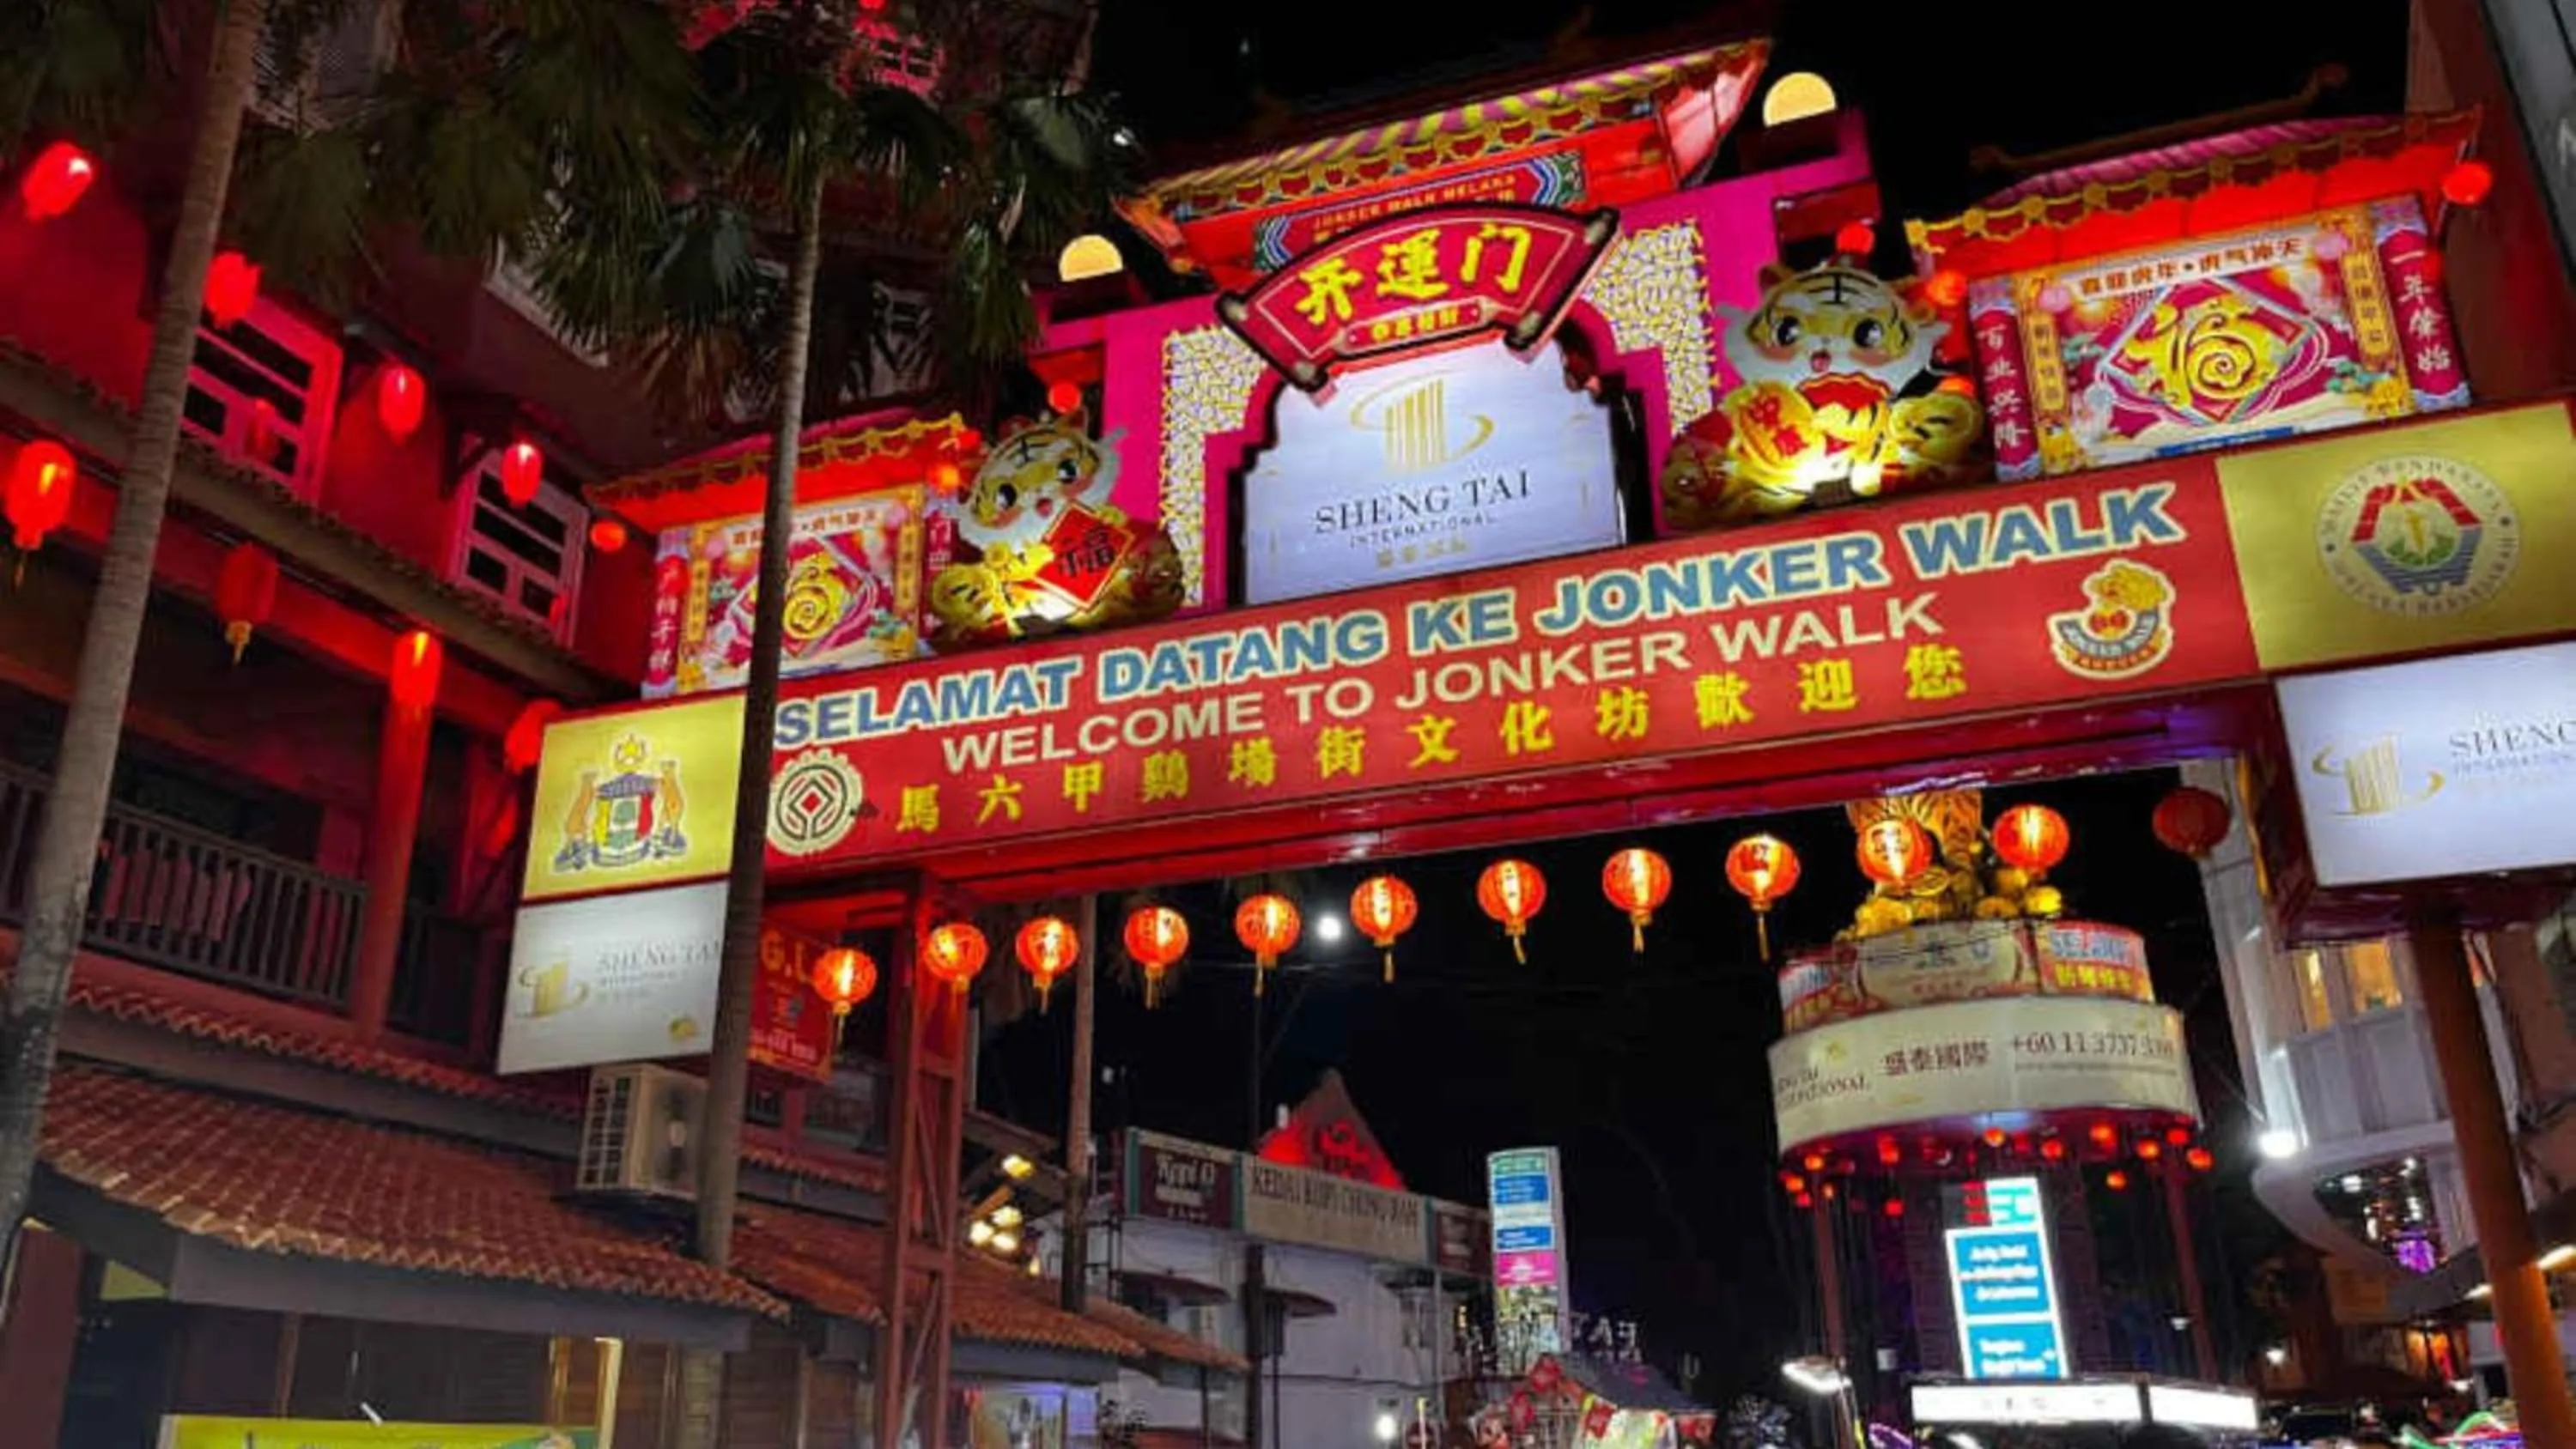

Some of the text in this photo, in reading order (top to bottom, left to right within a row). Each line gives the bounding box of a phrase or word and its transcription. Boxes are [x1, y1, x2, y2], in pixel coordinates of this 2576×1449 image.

[1315, 470, 1530, 535] SHENG TAI
[774, 482, 2189, 749] SELAMAT DATANG KE JONKER WALK
[941, 592, 1947, 776] WELCOME TO JONKER WALK
